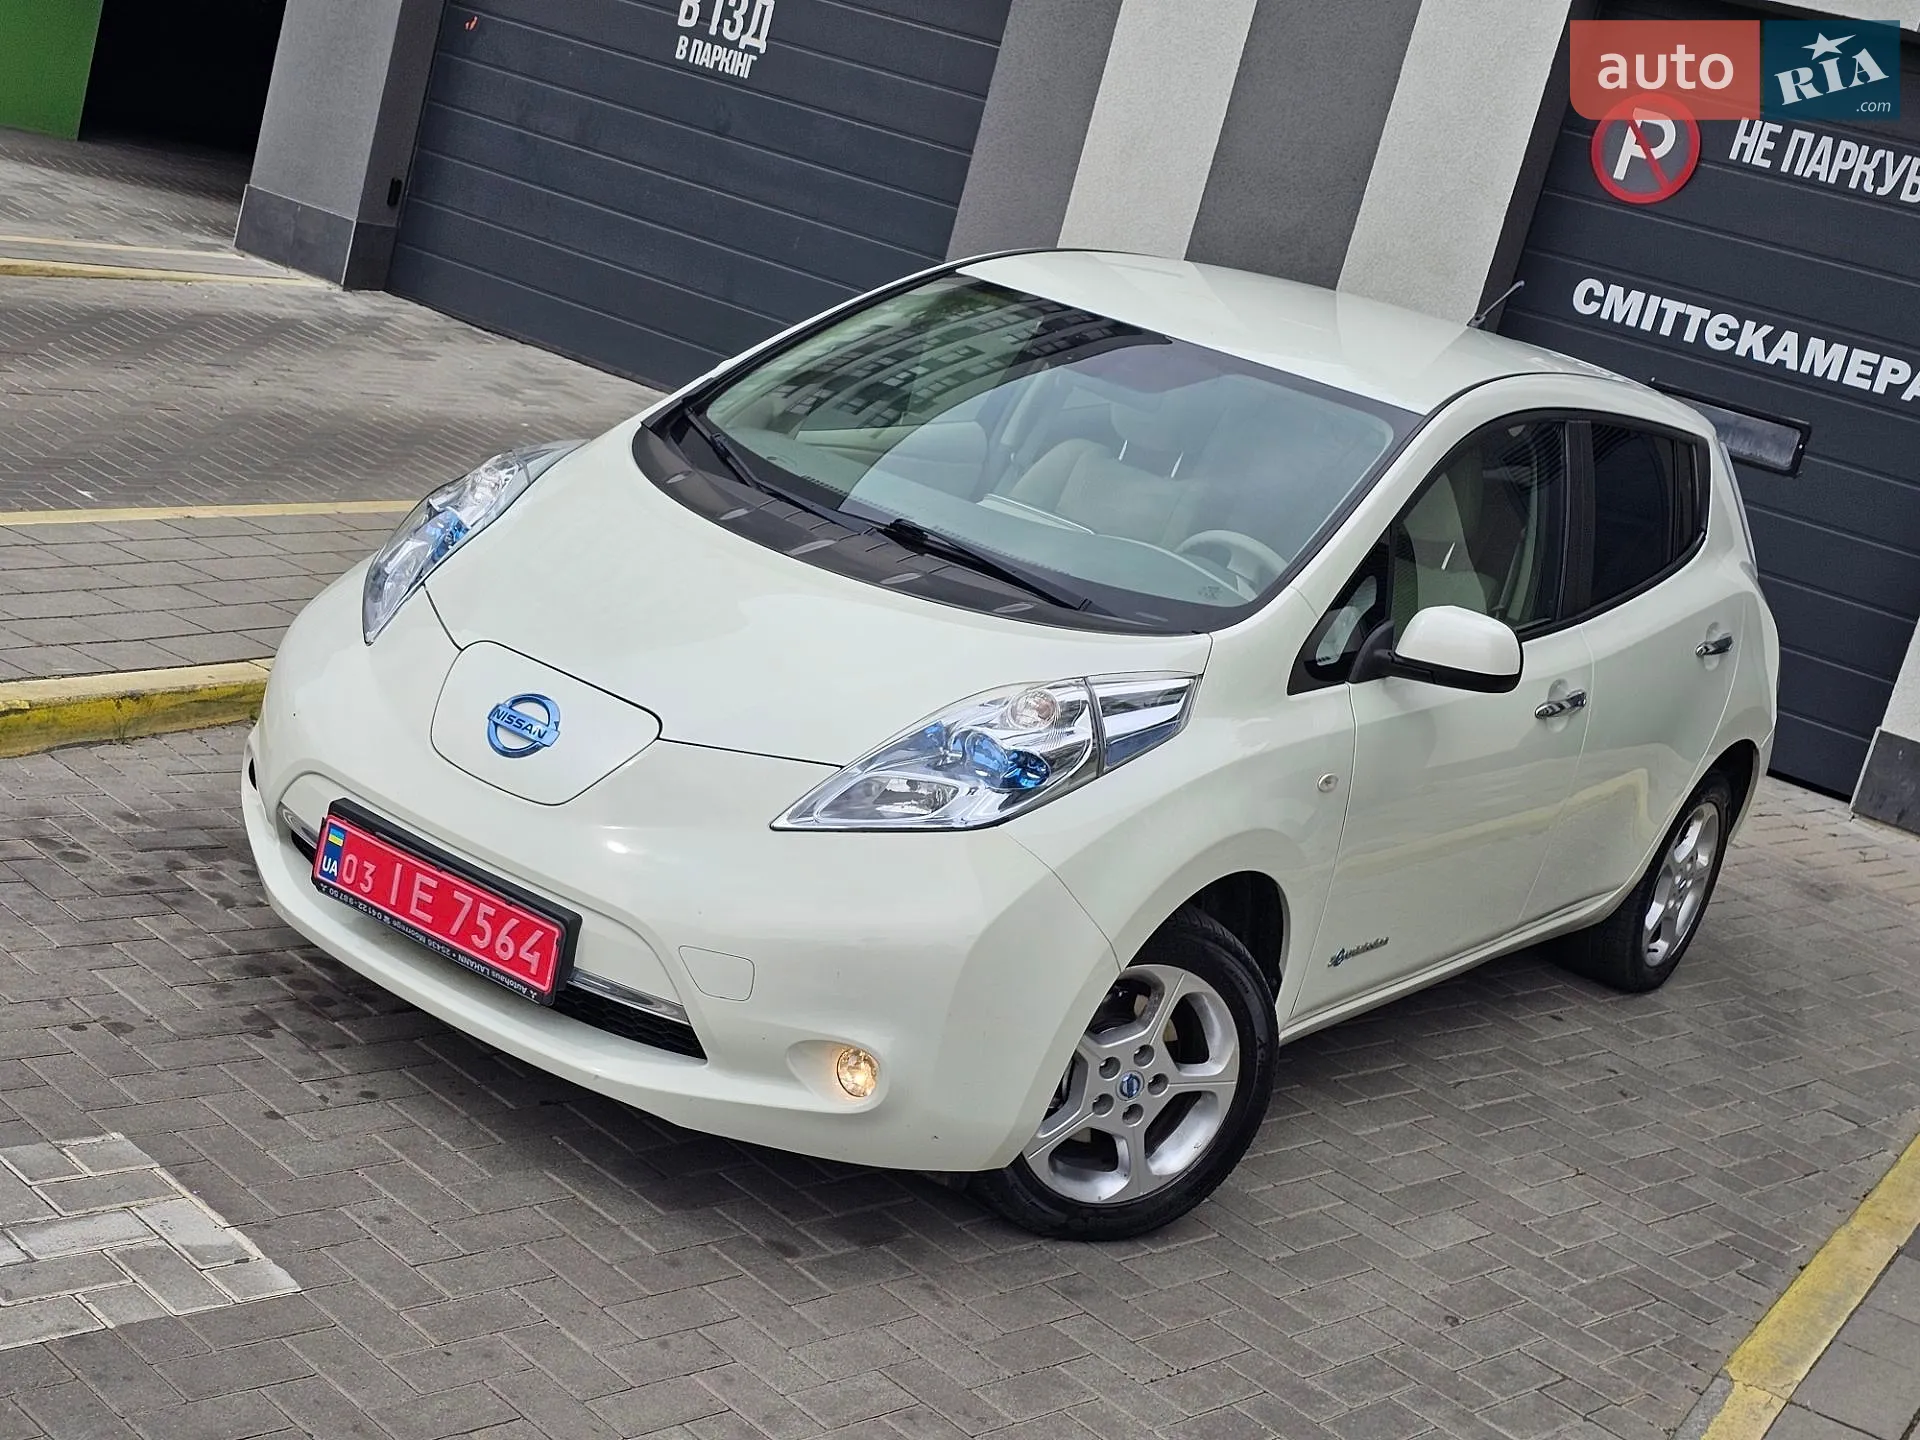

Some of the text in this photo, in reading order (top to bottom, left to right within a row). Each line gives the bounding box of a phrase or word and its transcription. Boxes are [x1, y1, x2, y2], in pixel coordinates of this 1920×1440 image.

[675, 35, 758, 79] В ПАРКІНГ
[1728, 117, 1784, 169] НЕ
[493, 708, 548, 739] NISSAN
[322, 855, 338, 877] UA
[342, 853, 544, 976] 03 IE 7564
[491, 970, 528, 995] Autohaus
